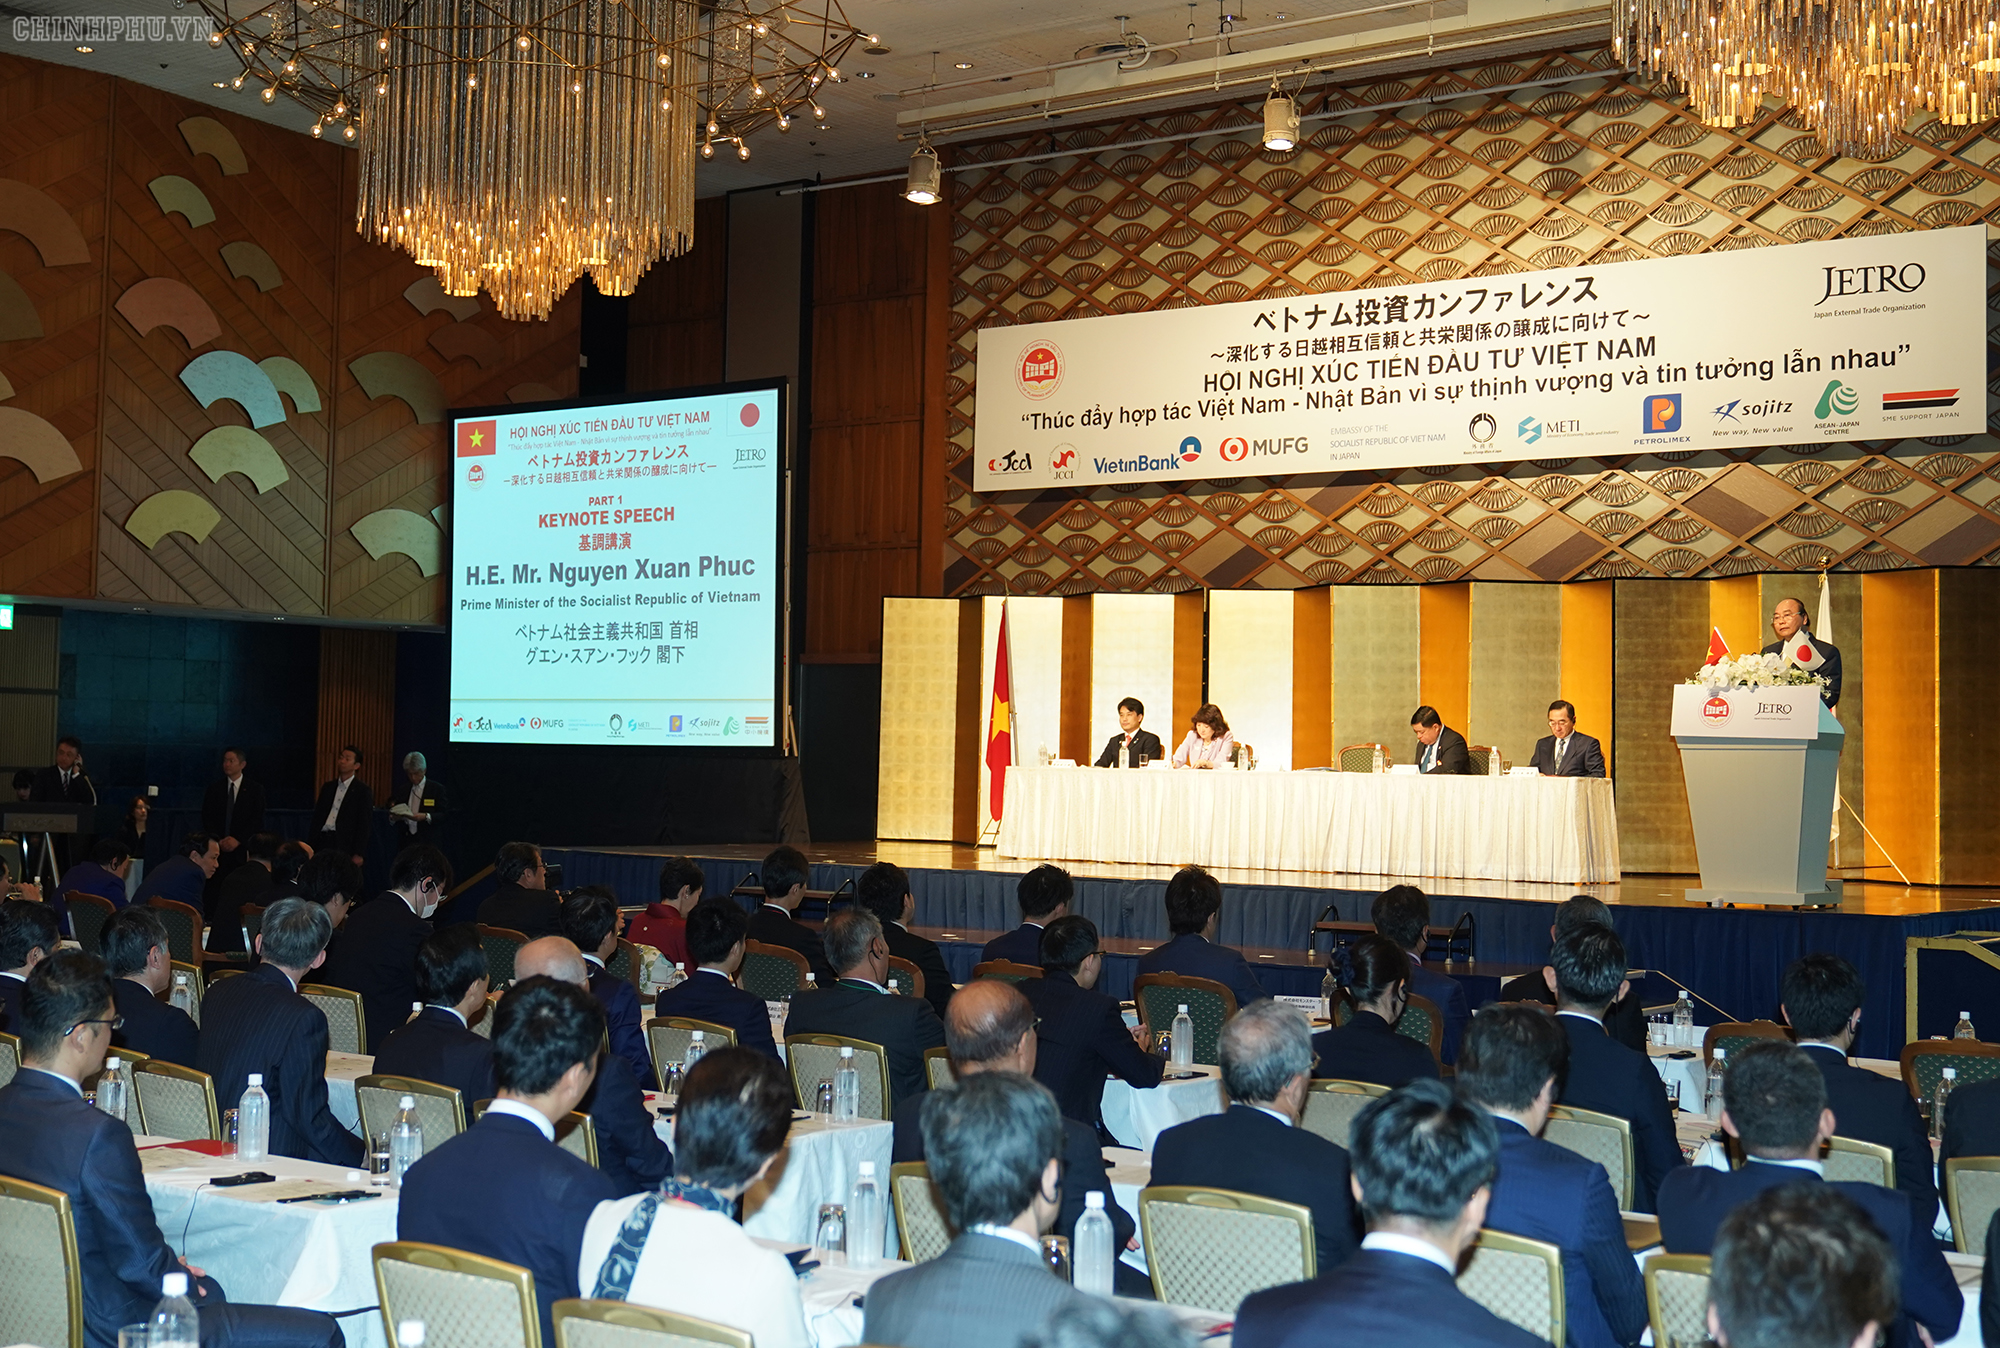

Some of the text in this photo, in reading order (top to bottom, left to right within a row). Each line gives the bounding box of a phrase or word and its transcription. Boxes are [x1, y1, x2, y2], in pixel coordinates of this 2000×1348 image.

[1814, 262, 1926, 306] JETRO
[1253, 276, 1598, 332] ベトナム投資カンファレンス
[1834, 308, 1860, 316] External
[1882, 303, 1926, 313] Organization
[1204, 336, 1656, 396] HỘI NGHỊ XÚC TIẾN ĐẦU TƯ VIỆT NAM
[1021, 411, 1074, 430] “Thúc
[1081, 404, 1113, 429] đẩy
[1120, 406, 1156, 426] hợp
[1163, 402, 1191, 420] tác
[1198, 398, 1234, 420] Việt
[1242, 396, 1285, 414] Nam
[1306, 389, 1353, 412] Nhật
[1361, 385, 1401, 406] Bản
[1410, 383, 1427, 402] vì
[1434, 384, 1464, 404] sự
[1470, 375, 1527, 401] thịnh
[1535, 373, 1613, 395] vượng
[1622, 365, 1648, 386] và
[1657, 363, 1687, 383] tin
[1695, 357, 1774, 381] tưởng
[1784, 348, 1821, 374] lẫn
[1831, 344, 1911, 370] nhau”
[1742, 400, 1793, 417] sojitz
[510, 411, 710, 441] HỘI NGHỊ XÚC TIẾN ĐẦU TƯ VIỆT NAM
[1330, 424, 1388, 435] EMBASSY OF THE
[1546, 420, 1580, 433] METI
[1253, 437, 1309, 457] MUFG
[1330, 438, 1363, 448] SOCIALIST
[1365, 436, 1398, 446] REPUBLIC
[1411, 434, 1426, 443] VIET
[1428, 434, 1446, 442] NAM
[1634, 437, 1690, 445] PETROLIMEX
[528, 445, 689, 469] ベトナム投資カンファレンス
[733, 448, 766, 464] JETRO
[1094, 454, 1180, 474] VietinBank
[1339, 452, 1360, 461] JAPAN
[1054, 471, 1074, 480] JCCI
[588, 496, 623, 506] PART 1
[539, 507, 675, 528] KEYNOTE SPEECH
[578, 532, 631, 551] 基調講演
[466, 556, 755, 587] H.E. Mr. Nguyen Xuan Phuc
[461, 591, 760, 610] Prime Minister of the Socialist Republic of Vietnam
[515, 620, 698, 641] ベトナム社会主義共和国 首相
[525, 646, 685, 664] グエン・スアン・フック 閣下
[1755, 702, 1792, 715] JETRO
